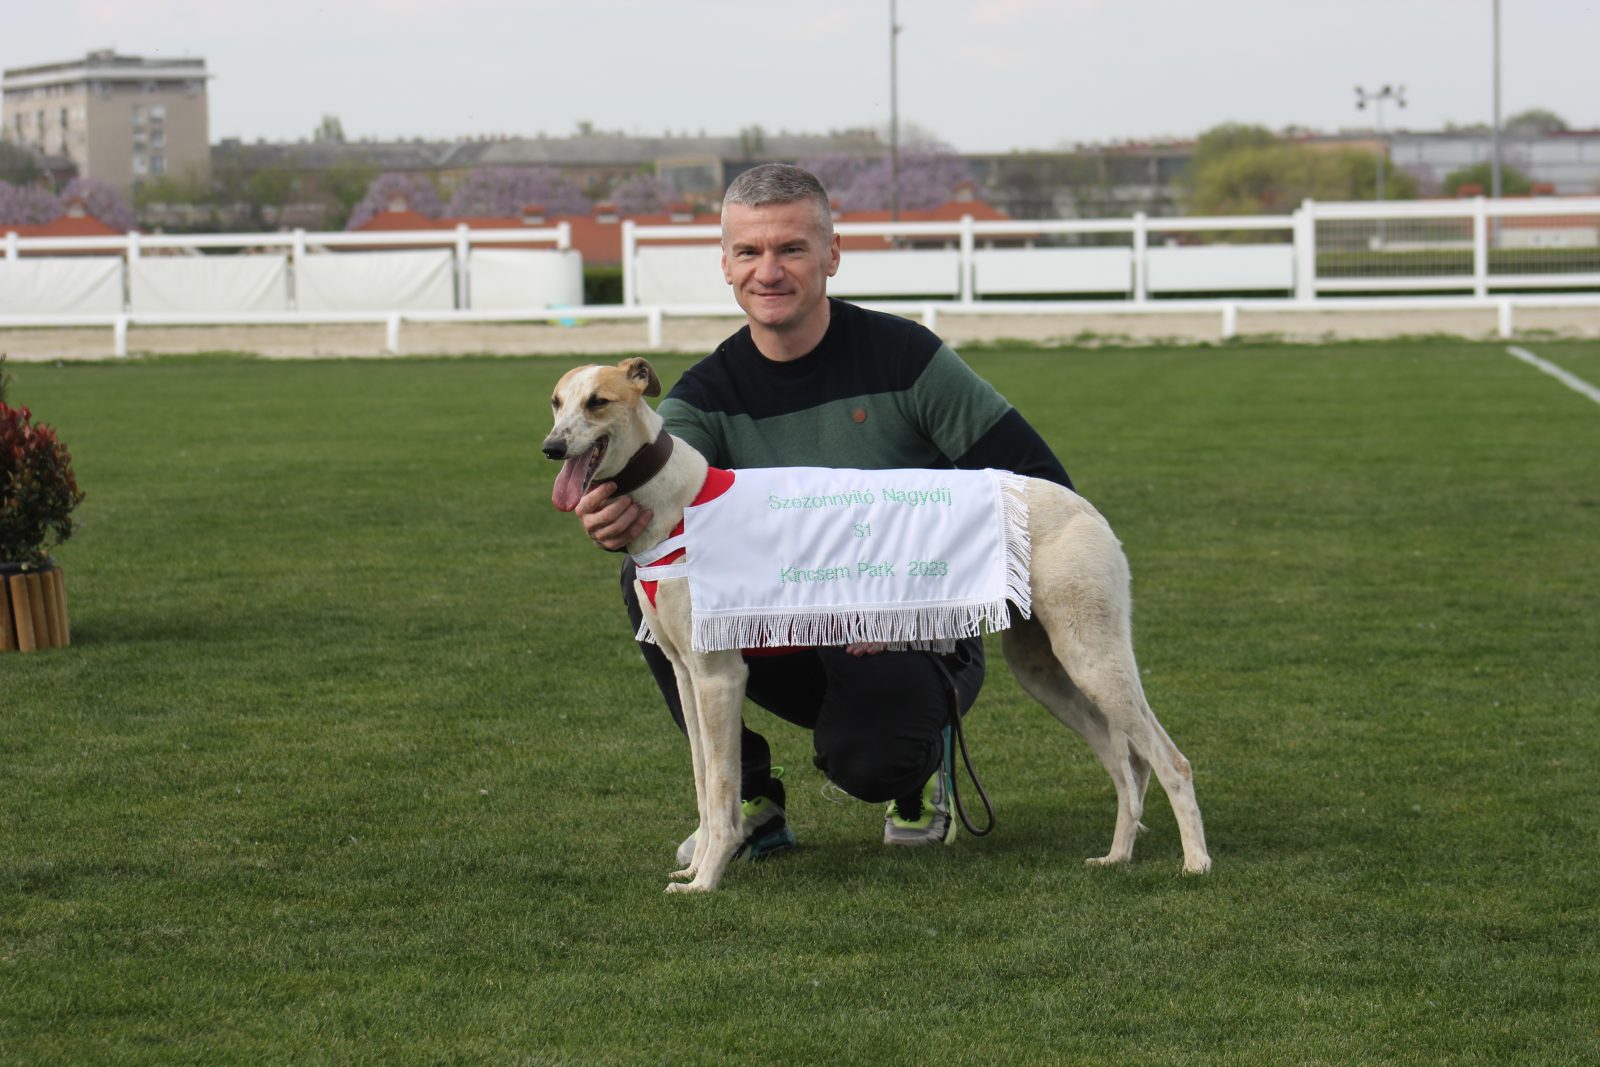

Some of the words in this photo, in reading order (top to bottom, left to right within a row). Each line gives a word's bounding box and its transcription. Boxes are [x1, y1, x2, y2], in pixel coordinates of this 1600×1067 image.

[769, 489, 875, 510] Szezonnyitó
[881, 487, 952, 507] Nagydíj
[853, 523, 871, 539] S1
[780, 565, 851, 583] Kincsem
[857, 561, 895, 578] Park
[908, 560, 949, 577] 2023
